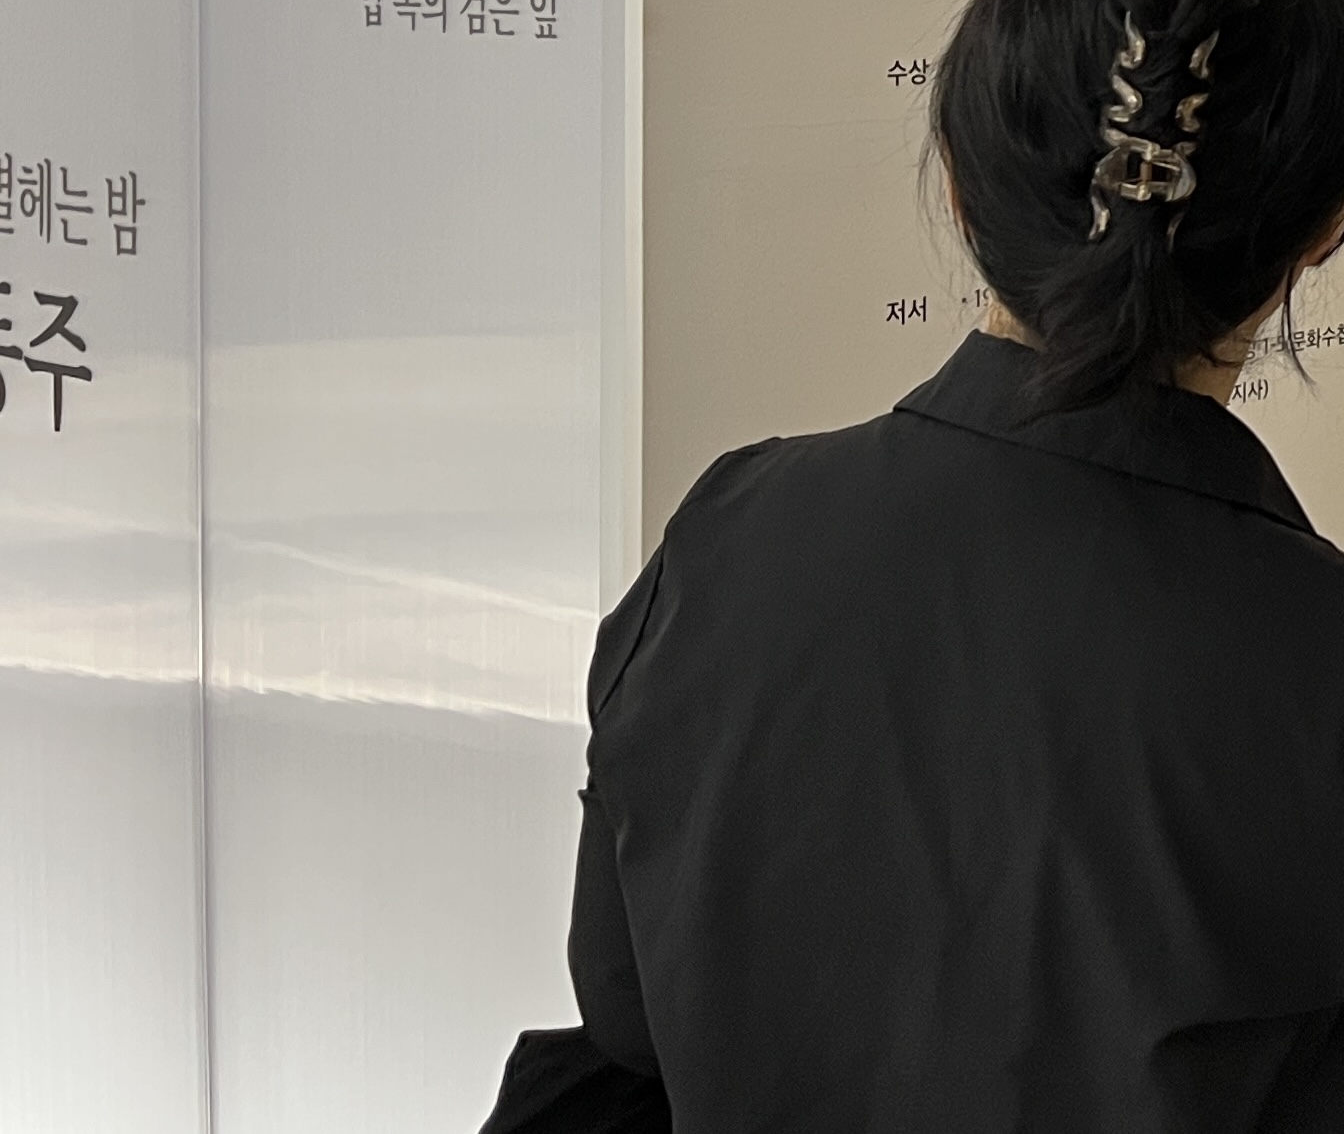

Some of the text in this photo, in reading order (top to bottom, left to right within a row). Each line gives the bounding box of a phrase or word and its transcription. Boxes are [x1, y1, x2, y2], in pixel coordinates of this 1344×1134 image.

[887, 58, 931, 88] 수상
[105, 170, 146, 256] 밤
[886, 295, 928, 326] 저서
